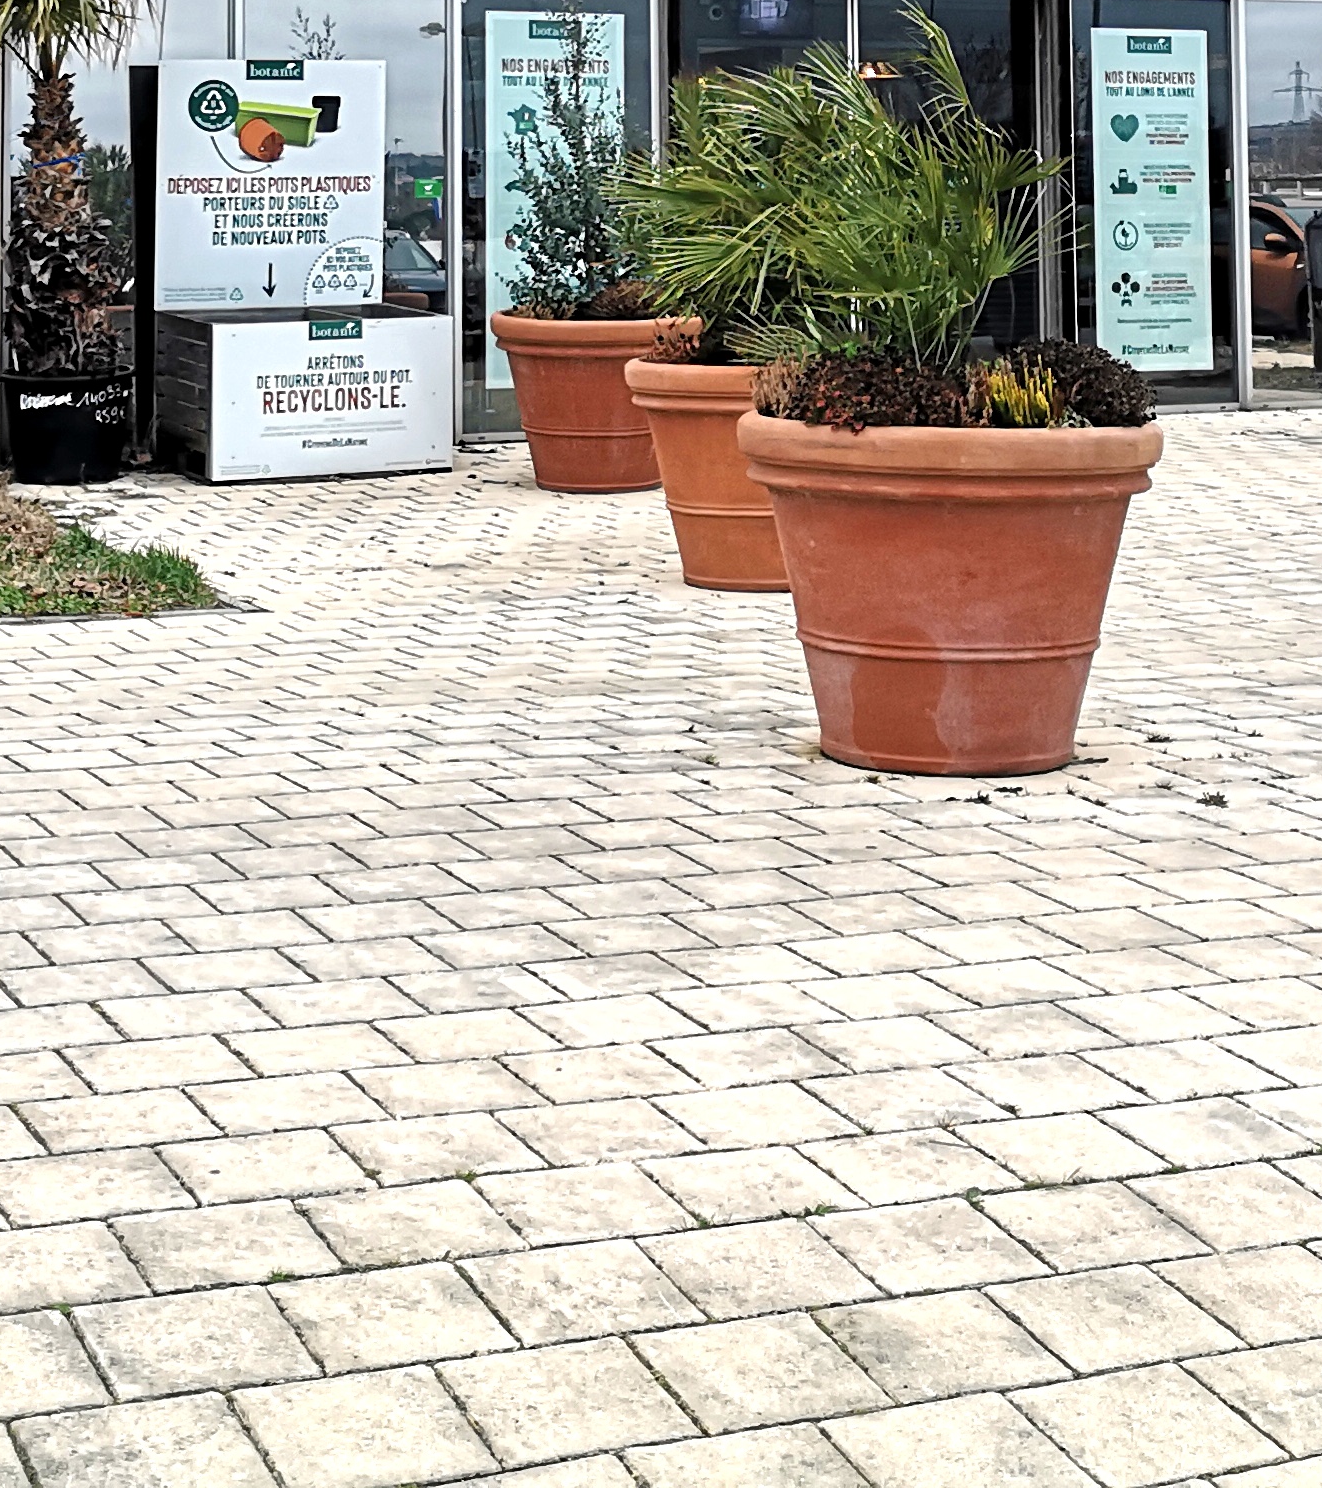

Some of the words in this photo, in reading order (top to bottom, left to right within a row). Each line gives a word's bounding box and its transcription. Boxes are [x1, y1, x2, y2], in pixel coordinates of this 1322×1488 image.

[1130, 38, 1170, 51] botanic
[250, 63, 301, 77] botanic
[501, 58, 524, 73] NOS
[502, 75, 523, 87] TOUT
[1105, 70, 1124, 84] NOS
[1126, 70, 1196, 85] ENGAGEMENTS
[1106, 86, 1123, 97] TOUT
[1125, 86, 1135, 97] AU
[167, 174, 223, 194] DÉPOSEZ
[226, 177, 241, 193] ICI
[243, 177, 266, 193] LES
[268, 176, 298, 193] POTS
[203, 196, 265, 212] PORTEURS
[269, 196, 284, 210] DU
[287, 195, 321, 210] SIGLE
[214, 214, 229, 228] ET
[232, 213, 264, 228] NOUS
[267, 210, 328, 228] CRÉERONS
[212, 231, 227, 246] DE
[231, 230, 294, 246] NOUVEAUX
[296, 229, 330, 245] POTS.
[311, 324, 360, 338] botanic
[307, 354, 365, 371] ARRÊTONS
[256, 375, 271, 390] DE
[274, 373, 324, 389] TOURNER
[327, 372, 370, 387] AUTOUR
[373, 370, 387, 384] DU
[390, 369, 413, 384] POT.
[262, 385, 407, 415] RECYCLONS-LE.
